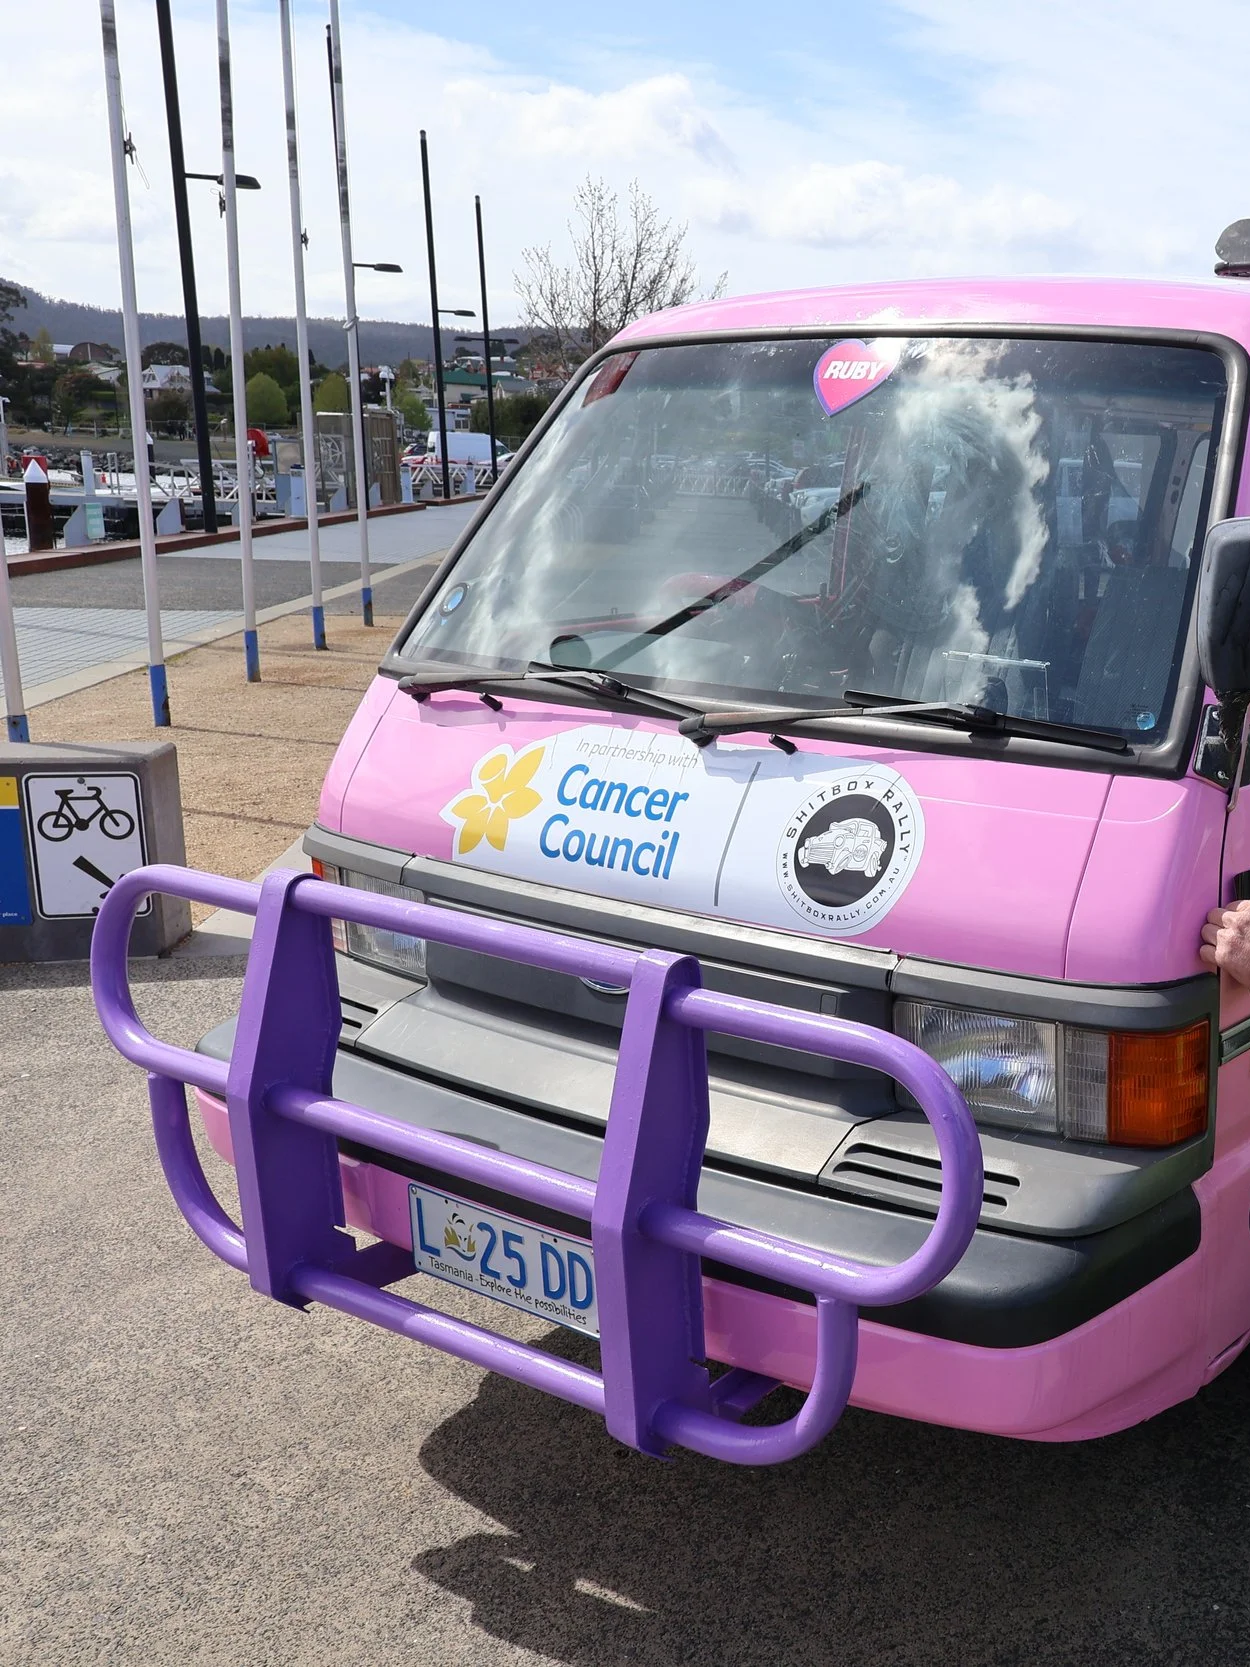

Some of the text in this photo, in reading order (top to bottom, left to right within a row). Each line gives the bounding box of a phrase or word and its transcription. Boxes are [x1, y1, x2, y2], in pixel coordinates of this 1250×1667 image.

[822, 360, 885, 380] RUBY
[576, 738, 699, 769] In partnership with
[557, 763, 690, 823] Cancer
[786, 780, 911, 854] SHITBOX RALLY
[539, 813, 680, 881] Council
[782, 851, 900, 922] WWW.SHITBOXRALLY.COM.AU
[416, 1197, 593, 1311] L 25 DD
[428, 1255, 474, 1283] Tasmania
[479, 1273, 512, 1297] Explore
[514, 1286, 534, 1306] the
[534, 1298, 588, 1325] possibilities
